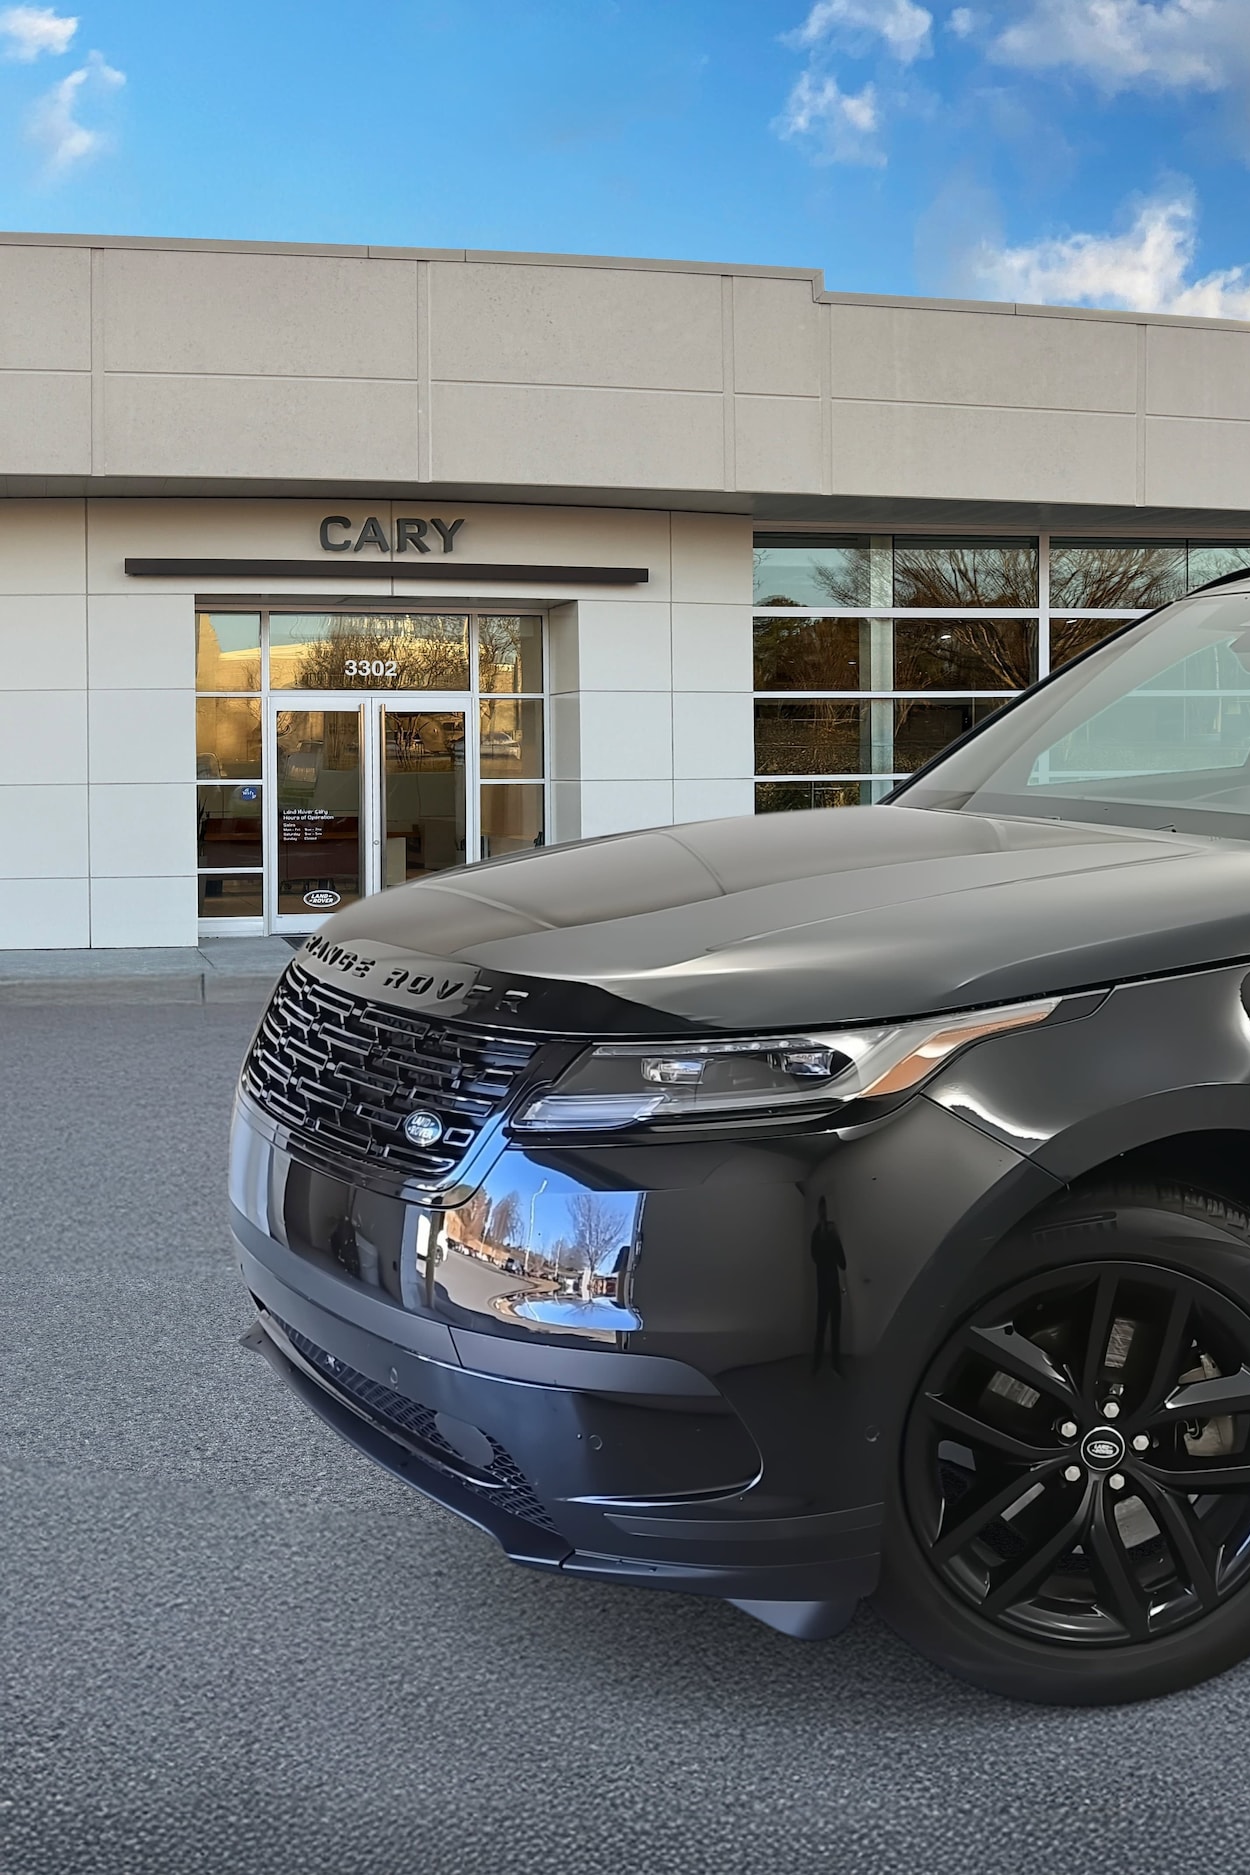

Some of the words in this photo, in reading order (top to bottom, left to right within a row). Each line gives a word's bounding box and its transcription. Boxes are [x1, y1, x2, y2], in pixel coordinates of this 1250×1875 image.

[319, 515, 466, 554] CARY
[344, 659, 398, 677] 3302
[305, 935, 376, 978] RANGE
[383, 967, 530, 1014] ROVER
